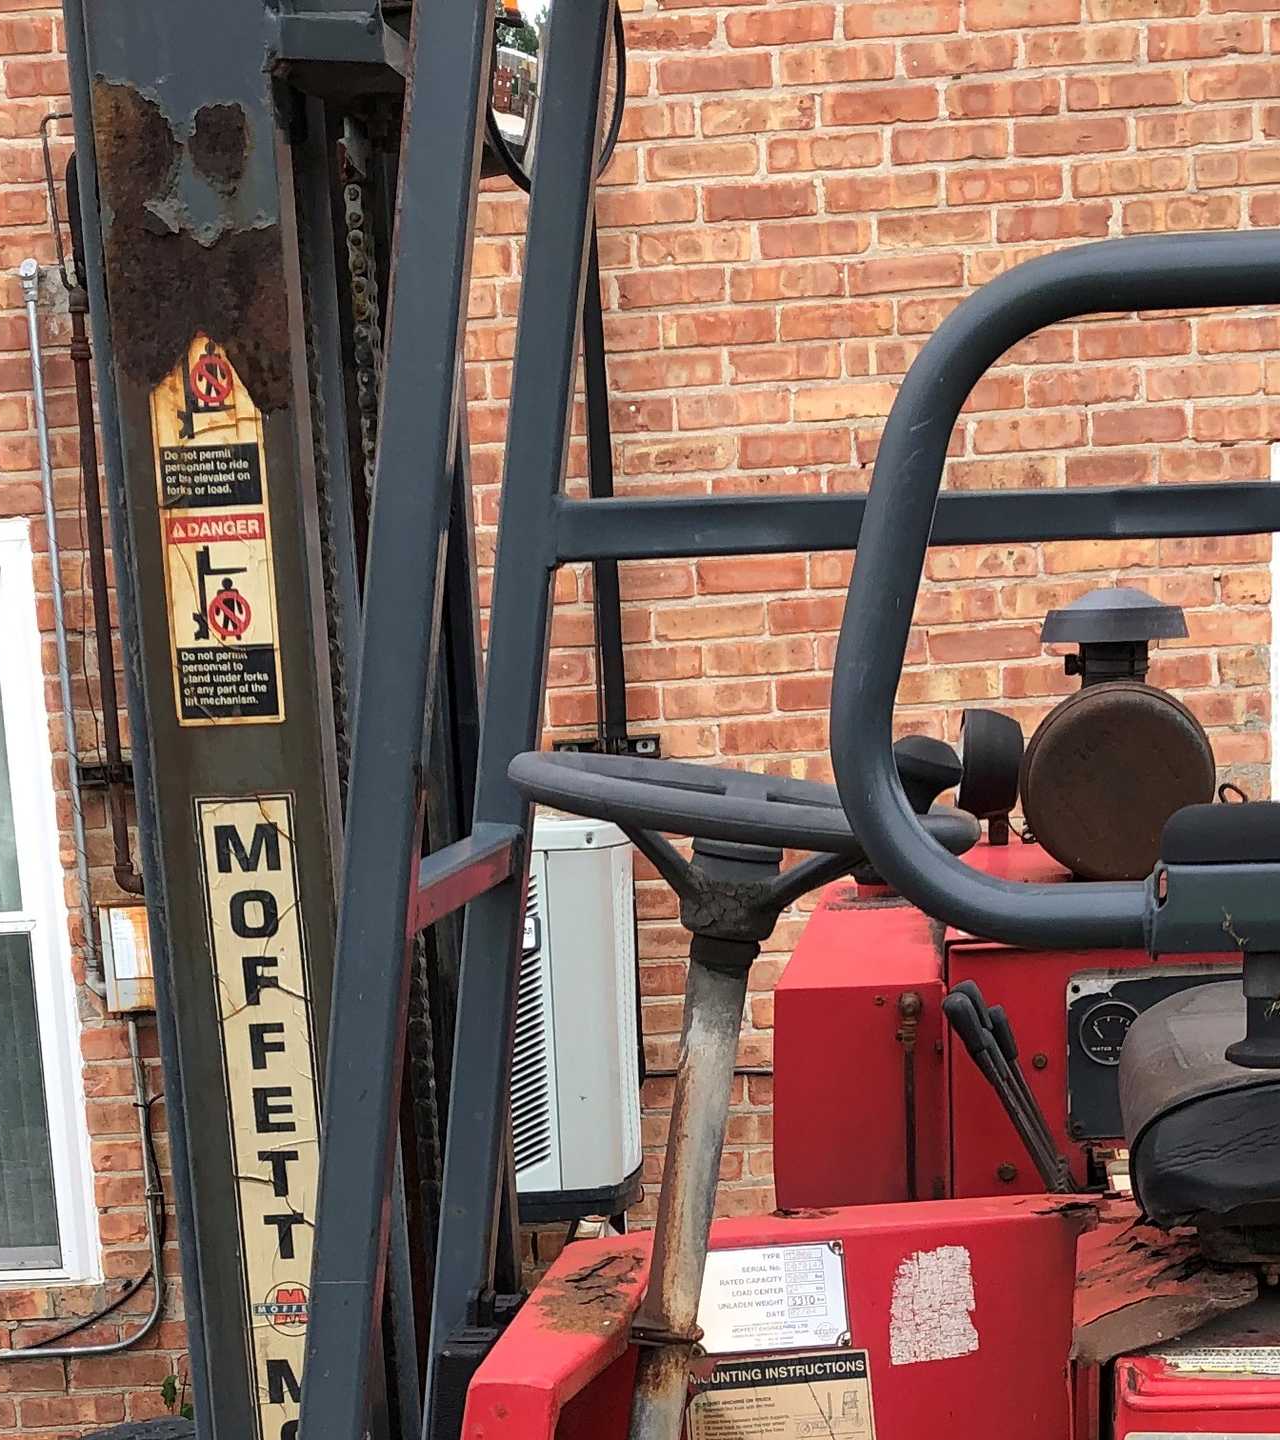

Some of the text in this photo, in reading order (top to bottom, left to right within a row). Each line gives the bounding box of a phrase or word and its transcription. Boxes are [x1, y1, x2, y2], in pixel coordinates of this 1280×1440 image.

[164, 450, 178, 461] Do
[165, 458, 249, 474] personnel to ride
[166, 474, 177, 484] or
[193, 471, 236, 484] elevated
[236, 472, 251, 480] on
[166, 484, 193, 496] forks
[194, 486, 206, 495] or
[186, 519, 260, 538] DANGER
[181, 651, 196, 661] Do
[197, 650, 214, 661] not
[182, 662, 244, 674] personnel to
[212, 673, 242, 683] under
[243, 672, 270, 682] forks
[196, 686, 214, 696] any
[216, 684, 237, 696] part
[238, 683, 249, 693] of
[250, 683, 268, 694] the
[213, 821, 305, 1260] MOFFETT
[719, 1278, 744, 1286] RATED
[746, 1276, 782, 1284] CAPACITY
[754, 1288, 784, 1296] CENTER
[718, 1300, 754, 1310] UNLADEN
[755, 1299, 784, 1308] WEIGHT
[766, 1310, 785, 1318] DATE
[765, 1360, 864, 1380] INSTRUCTIONS
